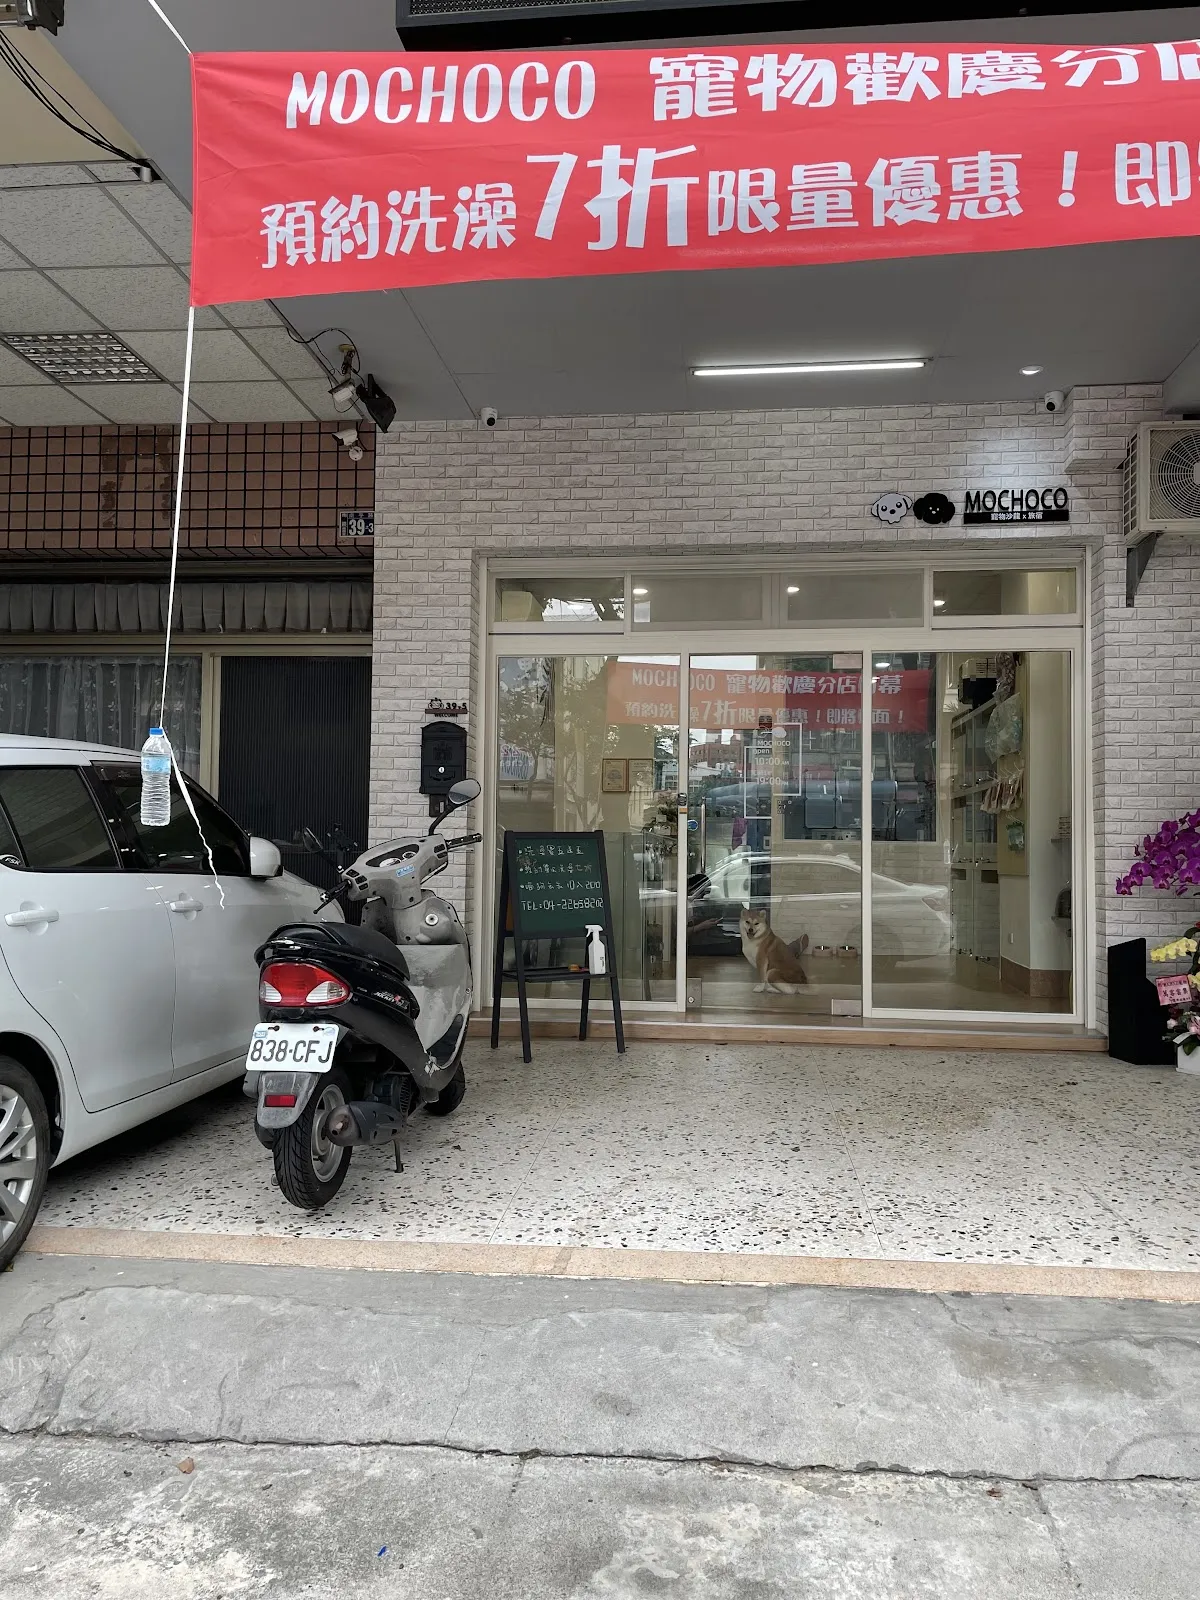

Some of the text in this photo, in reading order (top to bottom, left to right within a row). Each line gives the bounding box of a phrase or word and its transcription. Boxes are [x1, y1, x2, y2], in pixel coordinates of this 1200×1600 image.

[286, 60, 595, 129] MOCHOCO
[260, 141, 1200, 268] 預約洗澡7折限量優惠！即
[964, 488, 1068, 511] MOCHOCO
[755, 757, 780, 766] 10:00
[756, 777, 780, 786] 19:00
